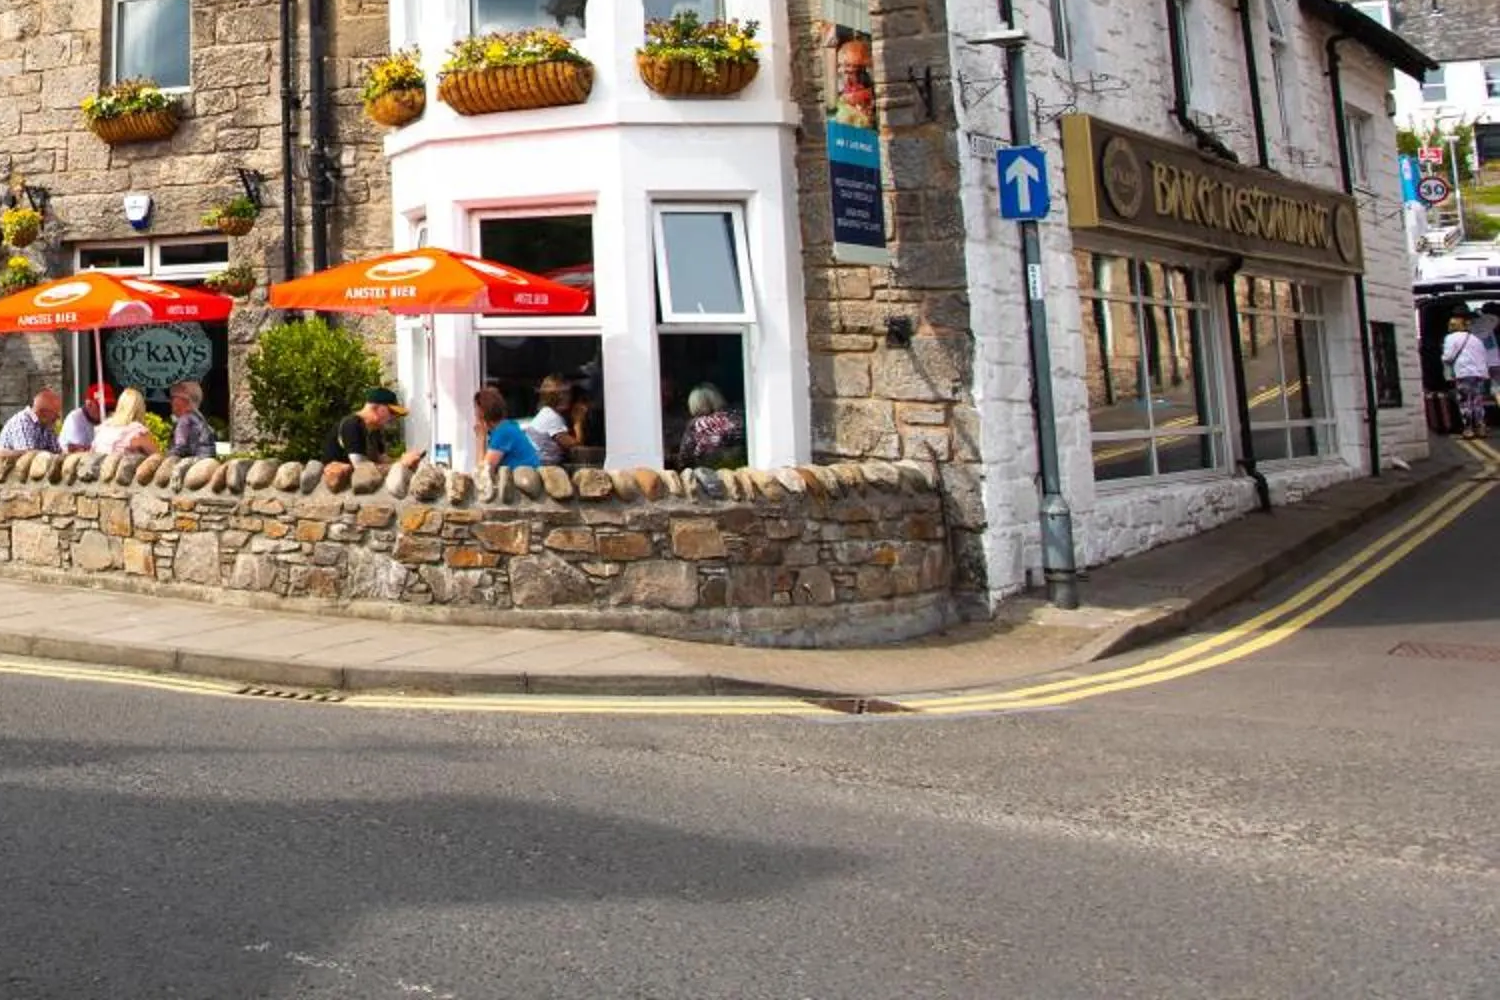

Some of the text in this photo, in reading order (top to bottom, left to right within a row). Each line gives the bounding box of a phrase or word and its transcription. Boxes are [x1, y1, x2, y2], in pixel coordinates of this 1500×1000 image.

[1150, 160, 1200, 224] BAR
[18, 311, 77, 327] AMSTEL BIER
